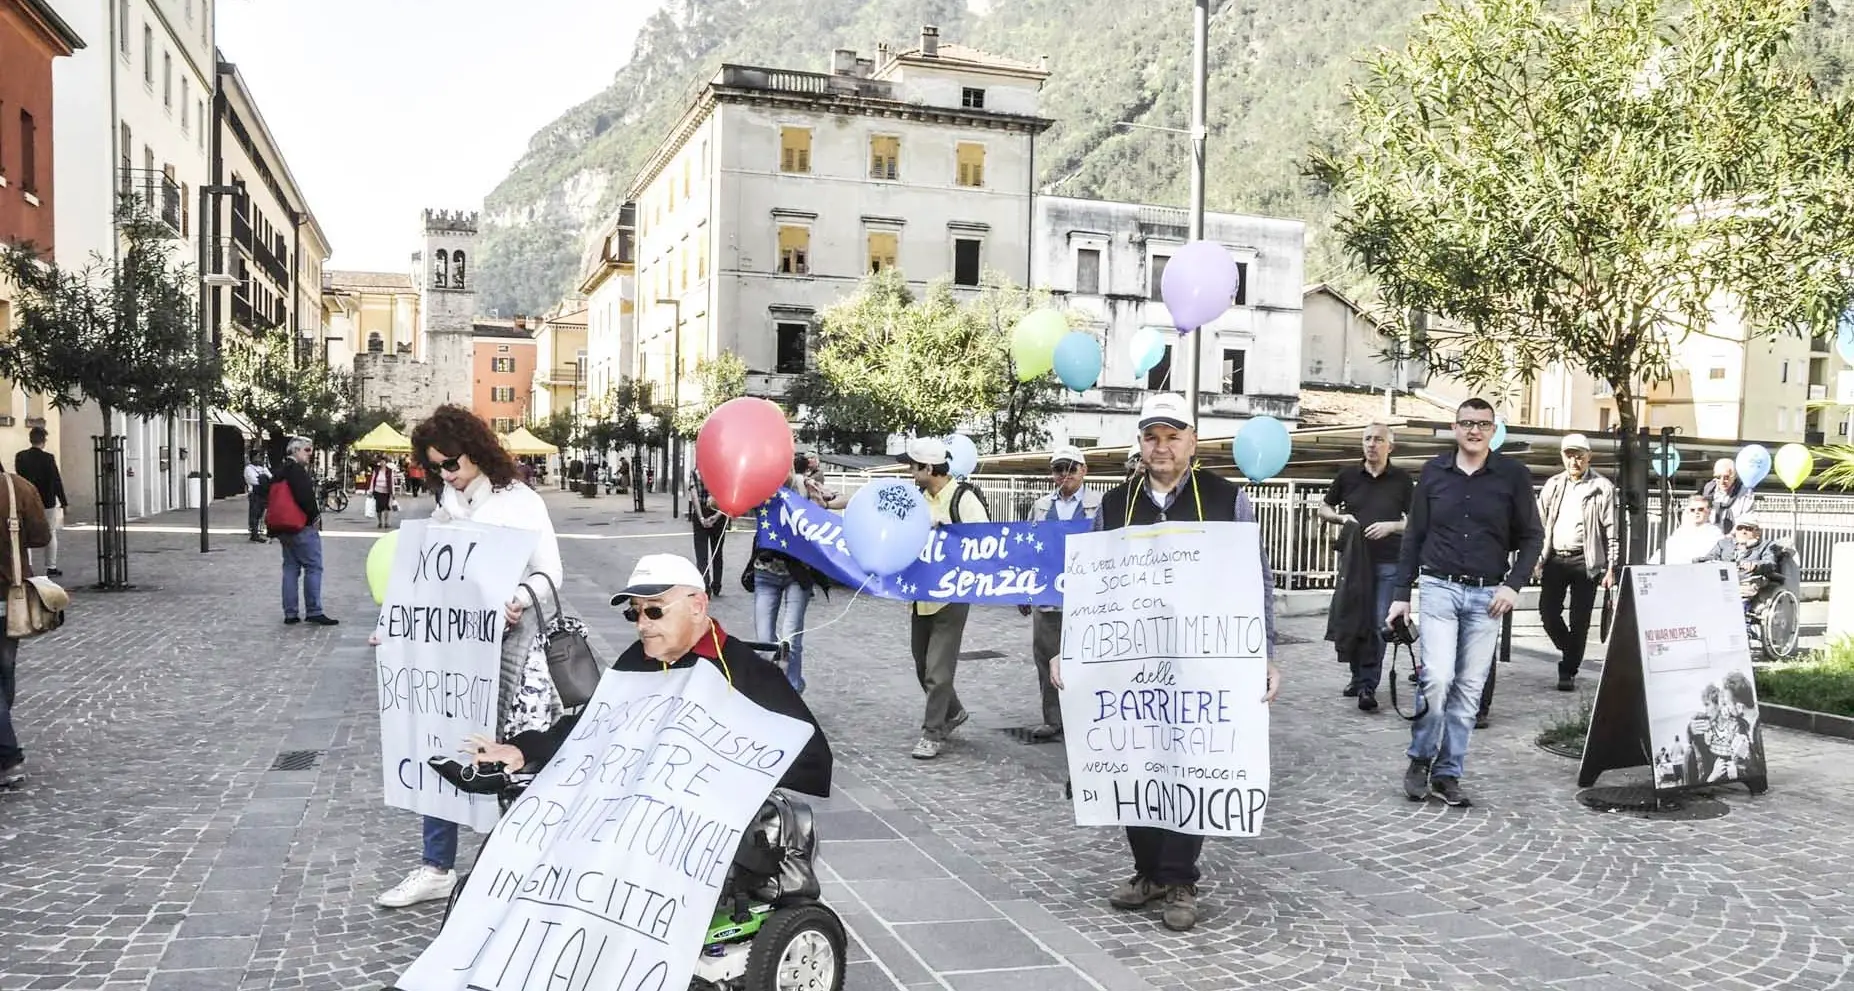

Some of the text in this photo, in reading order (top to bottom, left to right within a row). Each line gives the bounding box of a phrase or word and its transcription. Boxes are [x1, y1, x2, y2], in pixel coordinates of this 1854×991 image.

[960, 526, 1010, 562] noi
[1067, 551, 1087, 575] La
[1119, 548, 1200, 568] inclusione
[928, 566, 1047, 599] senza
[1095, 567, 1173, 595] SOCIALE
[1131, 597, 1166, 610] con
[1131, 660, 1176, 686] delle
[379, 661, 492, 728] BARRIERATI
[1093, 687, 1231, 725] BARRIERE
[1086, 725, 1236, 755] CULTURALI
[1082, 761, 1129, 774] verso
[1171, 764, 1247, 780] TIPOLOGIA
[1083, 778, 1267, 835] DI HANDICAP
